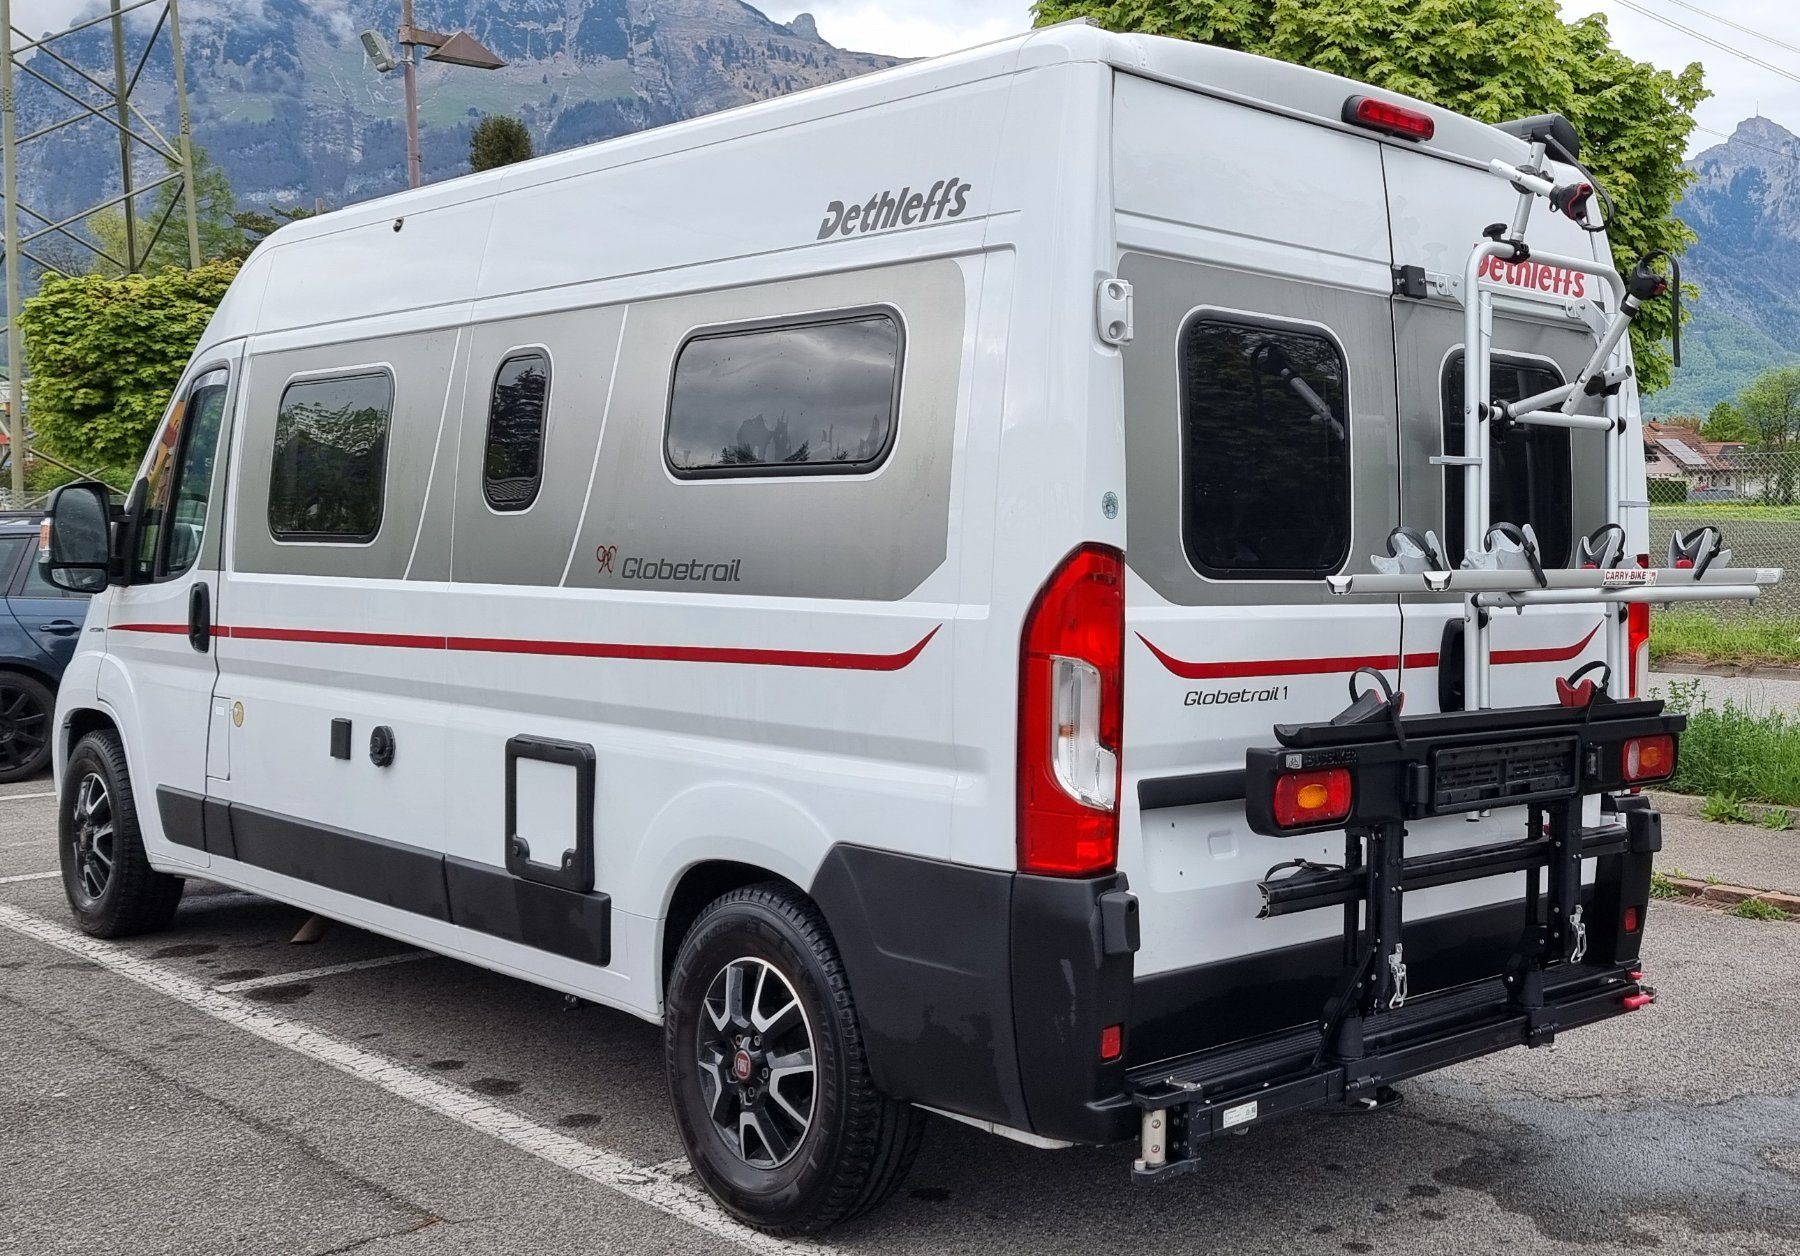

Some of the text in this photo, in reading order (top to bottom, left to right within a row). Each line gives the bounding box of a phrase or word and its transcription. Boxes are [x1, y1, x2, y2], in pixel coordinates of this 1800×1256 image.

[816, 177, 972, 241] Dethleffs
[621, 557, 742, 582] Globetrail
[1605, 571, 1647, 580] CARRY-BIKE
[1184, 685, 1289, 706] Globetrail 1
